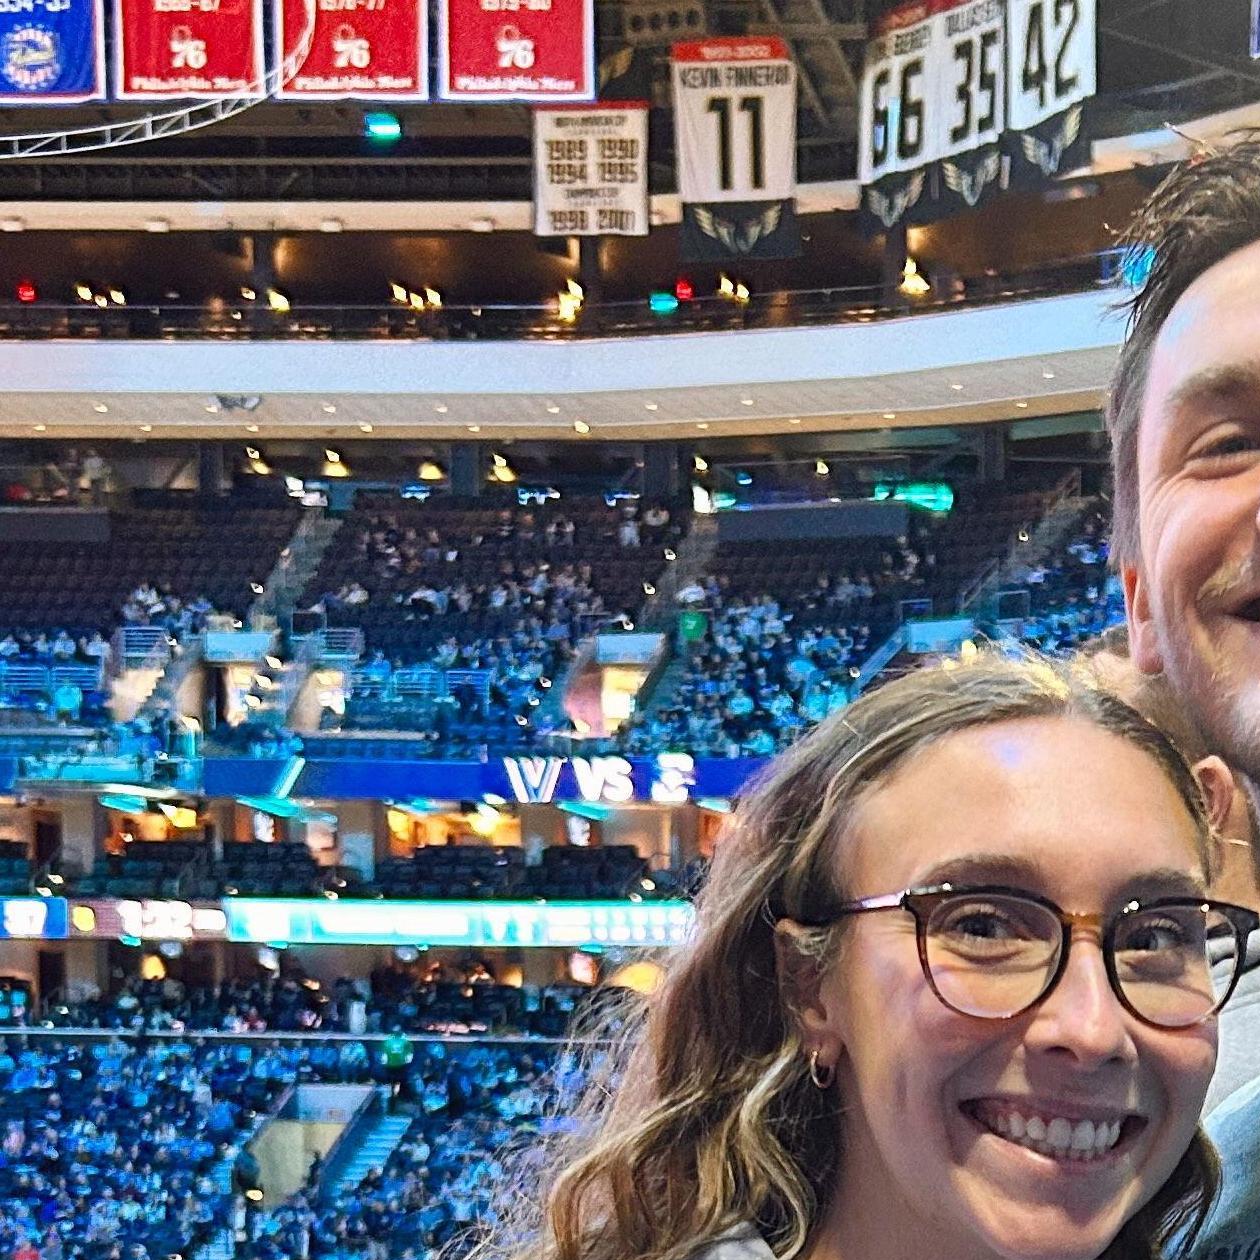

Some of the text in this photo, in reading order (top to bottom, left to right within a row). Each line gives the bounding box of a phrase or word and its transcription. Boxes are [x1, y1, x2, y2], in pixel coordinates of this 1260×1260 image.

[170, 40, 207, 68] 76
[333, 38, 370, 68] 76
[496, 38, 535, 68] 76
[1022, 0, 1079, 109] 42
[679, 67, 720, 88] KEVIN
[951, 28, 1000, 144] 35
[872, 56, 925, 168] 66
[707, 95, 766, 190] 11
[571, 755, 634, 802] VS
